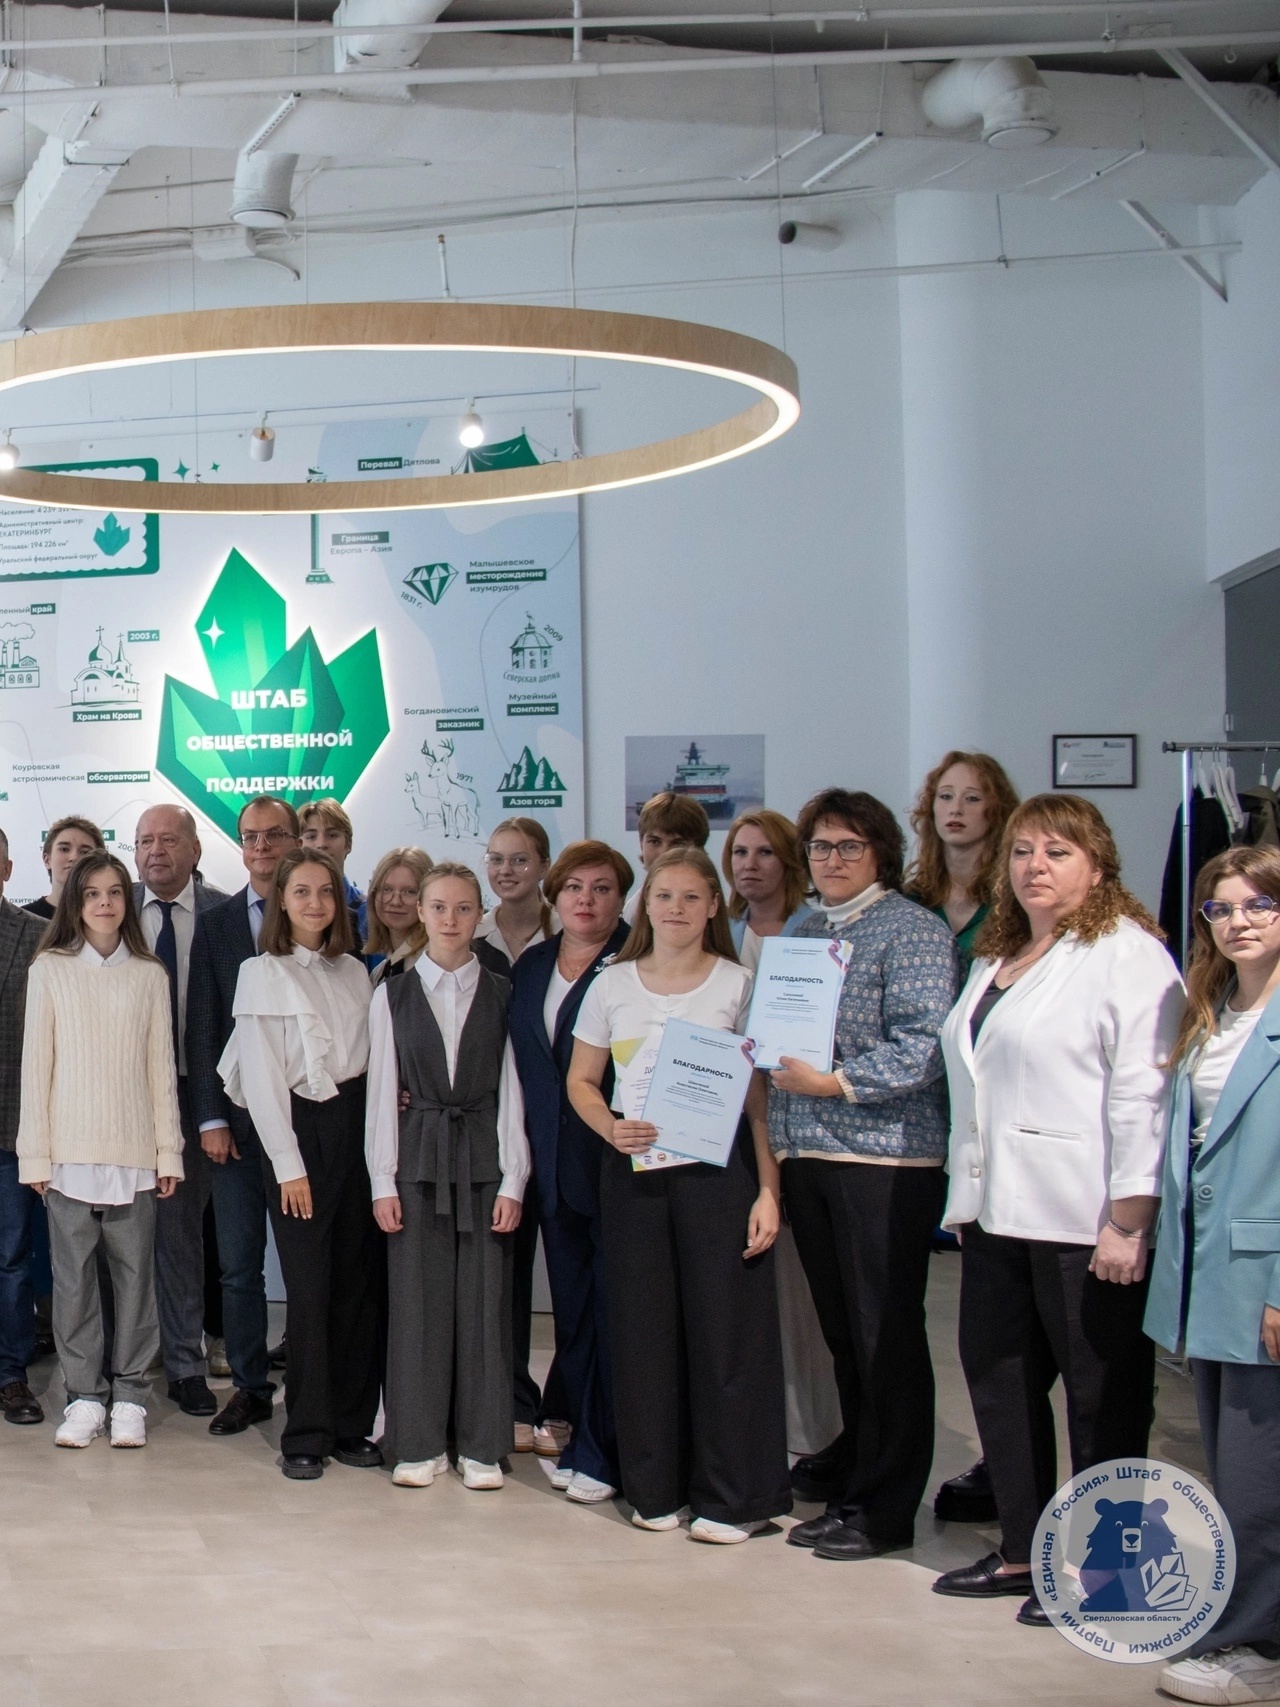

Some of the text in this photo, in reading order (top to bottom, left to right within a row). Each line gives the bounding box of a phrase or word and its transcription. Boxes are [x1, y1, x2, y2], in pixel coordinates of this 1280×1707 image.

[360, 458, 440, 470] Перевал Дятлова
[0, 519, 61, 529] Административный
[0, 528, 52, 538] ЕКАТЕРИНБУРГ
[341, 533, 379, 544] Граница
[0, 543, 29, 551] Площадь:
[31, 541, 43, 549] 194
[44, 540, 57, 548] 226
[330, 546, 362, 556] Европа
[371, 545, 392, 554] Азия
[0, 553, 98, 564] Уральский федеральный округ
[470, 558, 535, 568] Малышевское
[470, 570, 544, 581] месторождение
[470, 583, 520, 593] изумрудов
[400, 591, 417, 605] 1831
[32, 605, 53, 615] край
[130, 632, 159, 641] 2003 г.
[544, 624, 563, 642] 2009
[503, 671, 560, 683] Северская домна
[231, 689, 307, 710] ШТАБ
[509, 692, 557, 702] Музейный
[404, 706, 480, 715] Богдановичский
[510, 705, 556, 713] комплекс
[76, 712, 98, 721] Храм
[112, 711, 139, 721] Крови
[437, 721, 480, 729] заказник
[187, 729, 352, 752] ОБЩЕСТВЕННОЙ
[12, 763, 60, 772] Коуровская
[12, 773, 148, 783] астрономическая обсерватория
[456, 772, 473, 783] 1971
[206, 776, 334, 793] ПОДДЕРЖКИ
[510, 798, 555, 807] Азов гора
[770, 975, 824, 984] БЛАГОДАРНОСТЬ
[673, 1059, 733, 1079] БЛАГОДАРНОСТЬ
